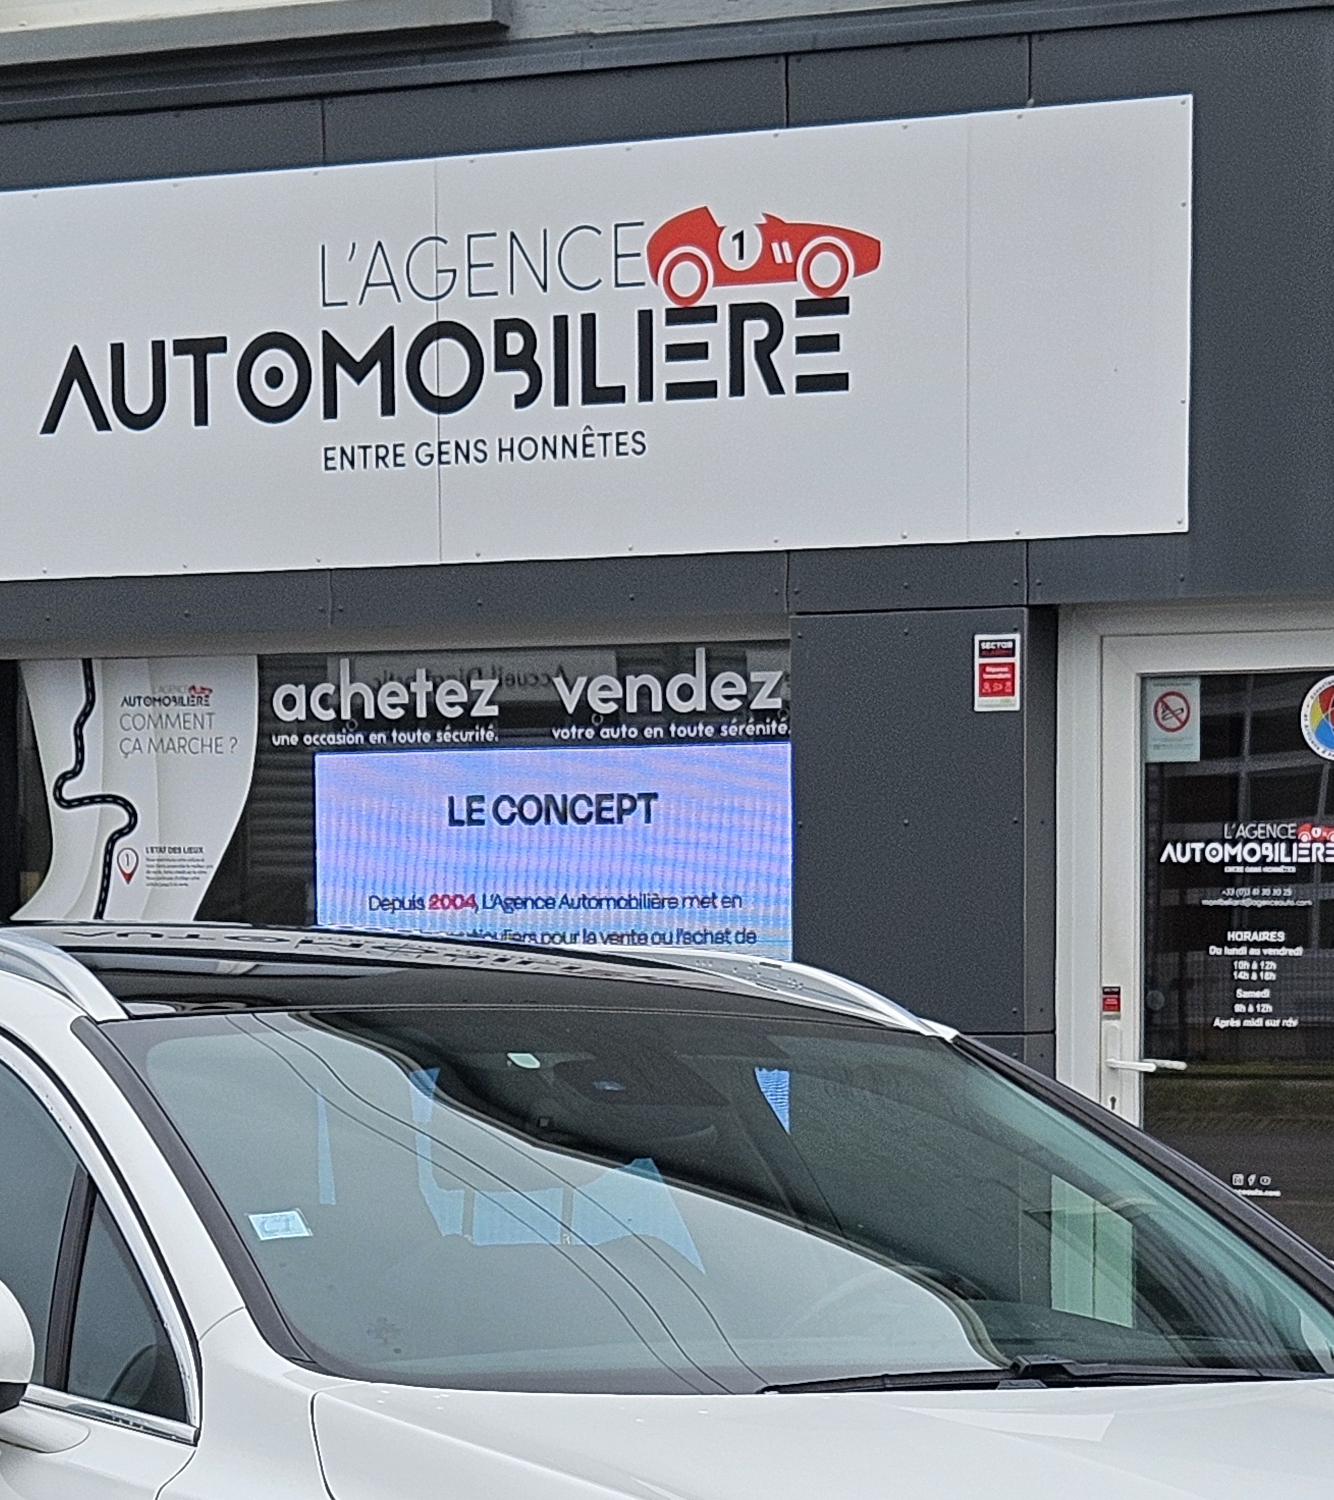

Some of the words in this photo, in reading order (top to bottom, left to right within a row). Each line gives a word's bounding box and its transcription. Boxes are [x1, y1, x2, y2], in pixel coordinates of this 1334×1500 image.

[320, 221, 646, 308] L'AGENCE
[322, 442, 406, 471] ENTRE
[414, 437, 488, 467] GENS
[497, 425, 647, 462] HONNÊTES
[273, 658, 499, 721] achetez
[553, 647, 783, 714] vendez
[119, 712, 215, 731] COMMENT
[552, 725, 595, 740] votre
[600, 724, 638, 739] auto
[643, 727, 664, 738] en
[669, 721, 714, 738] toute
[271, 734, 299, 746] une
[303, 728, 364, 745] occasion
[369, 733, 386, 744] en
[391, 728, 431, 744] toute
[436, 724, 498, 743] sécurité.
[119, 737, 143, 759] ÇA
[147, 736, 224, 754] MARCHE
[229, 736, 238, 754] ?
[447, 794, 485, 827] LE
[492, 792, 659, 826] CONCEPT
[1224, 823, 1297, 839] L'AGENCE
[368, 894, 425, 914] Depuis
[428, 893, 479, 914] 2004,
[482, 893, 555, 914] L'Agence
[558, 893, 679, 909] Automobilière
[682, 893, 718, 909] met
[721, 895, 743, 909] en
[540, 931, 580, 946] pour
[583, 928, 597, 945] la
[600, 929, 648, 945] vente
[652, 932, 672, 945] ou
[734, 927, 757, 944] de
[1227, 931, 1285, 942] HORAIRES
[1209, 946, 1223, 955] Du
[1224, 946, 1247, 955] lundi
[1262, 946, 1303, 956] vendredi
[1236, 988, 1270, 998] Samedi
[1213, 1017, 1241, 1029] Après
[1242, 1018, 1264, 1027] midi
